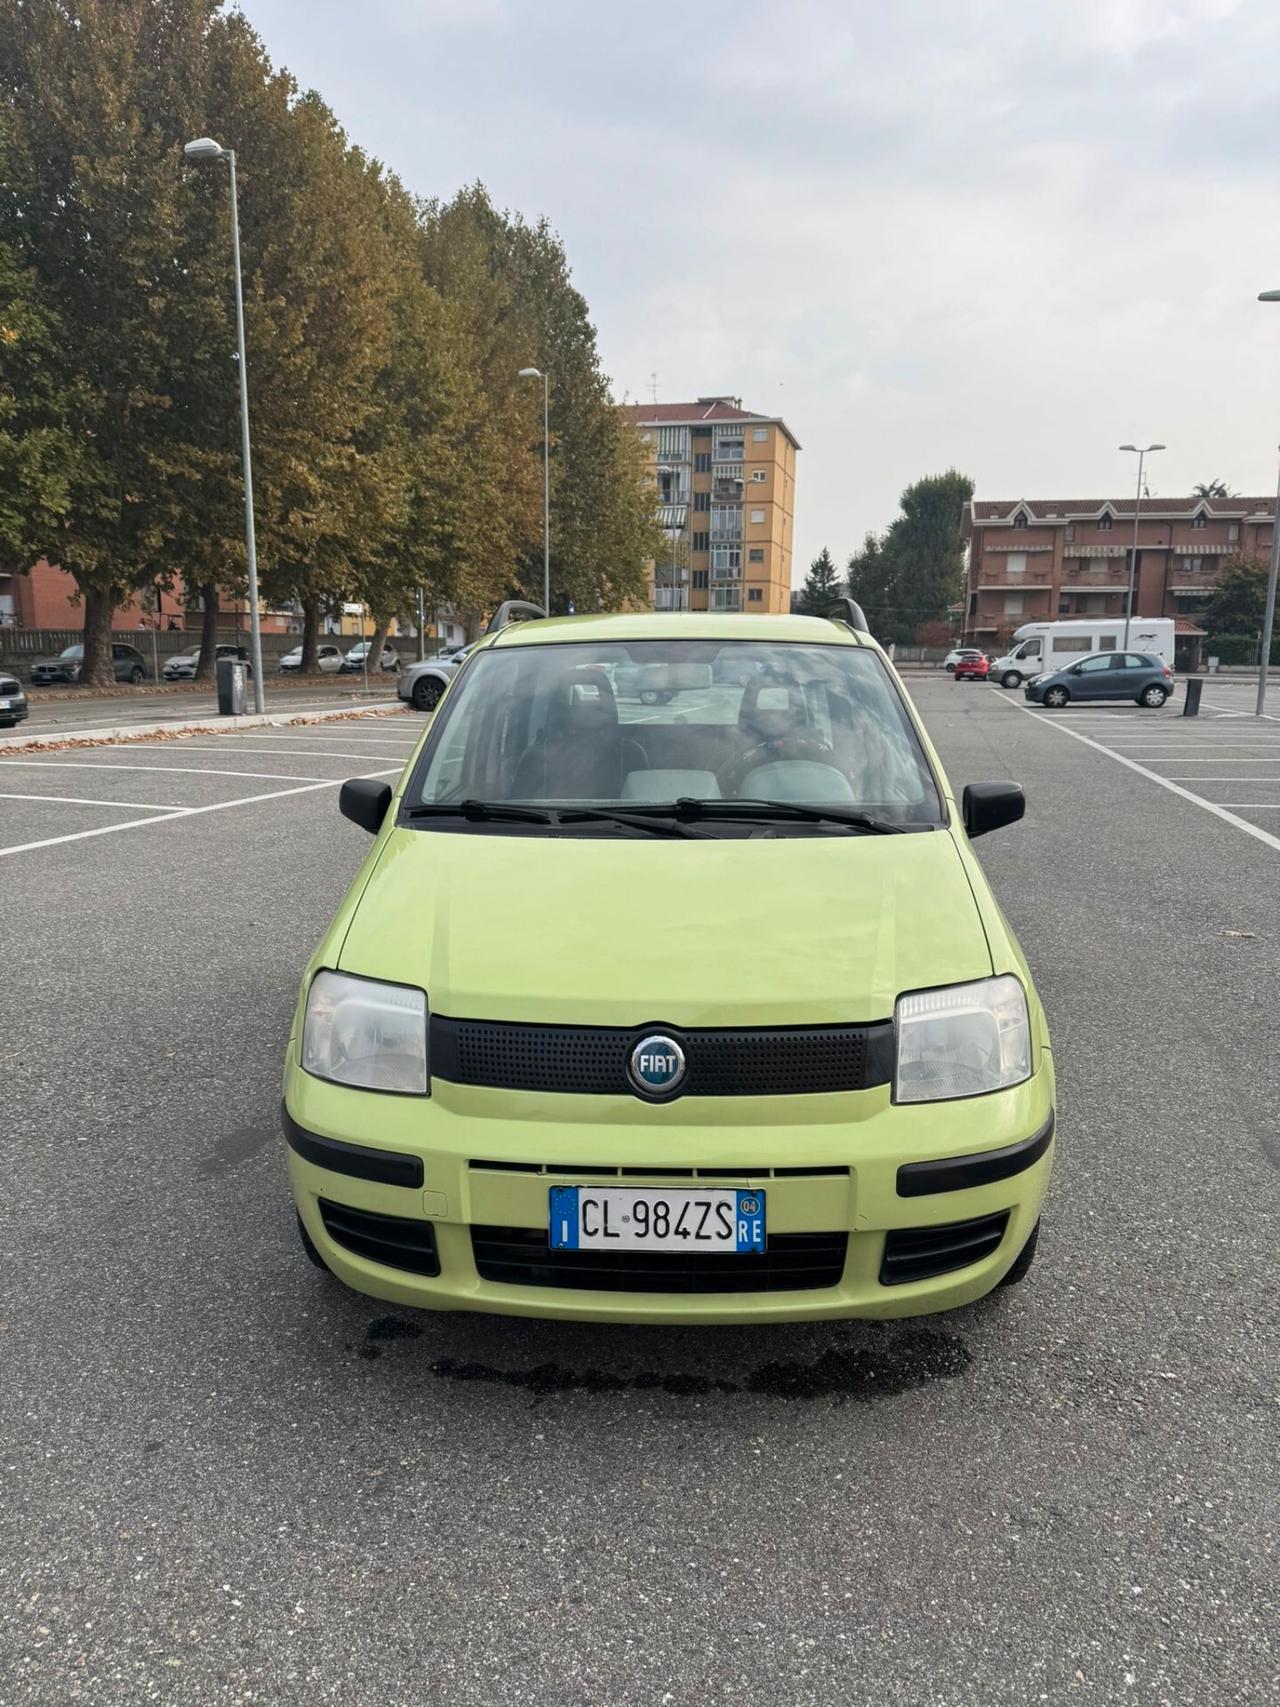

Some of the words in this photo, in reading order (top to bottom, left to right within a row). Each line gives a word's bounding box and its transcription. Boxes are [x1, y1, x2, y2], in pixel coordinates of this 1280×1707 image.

[640, 1055, 676, 1073] FIAT
[742, 1200, 757, 1212] 04
[582, 1199, 620, 1238] CL
[632, 1200, 733, 1240] 984ZS
[562, 1220, 569, 1242] I
[738, 1220, 762, 1243] RE
